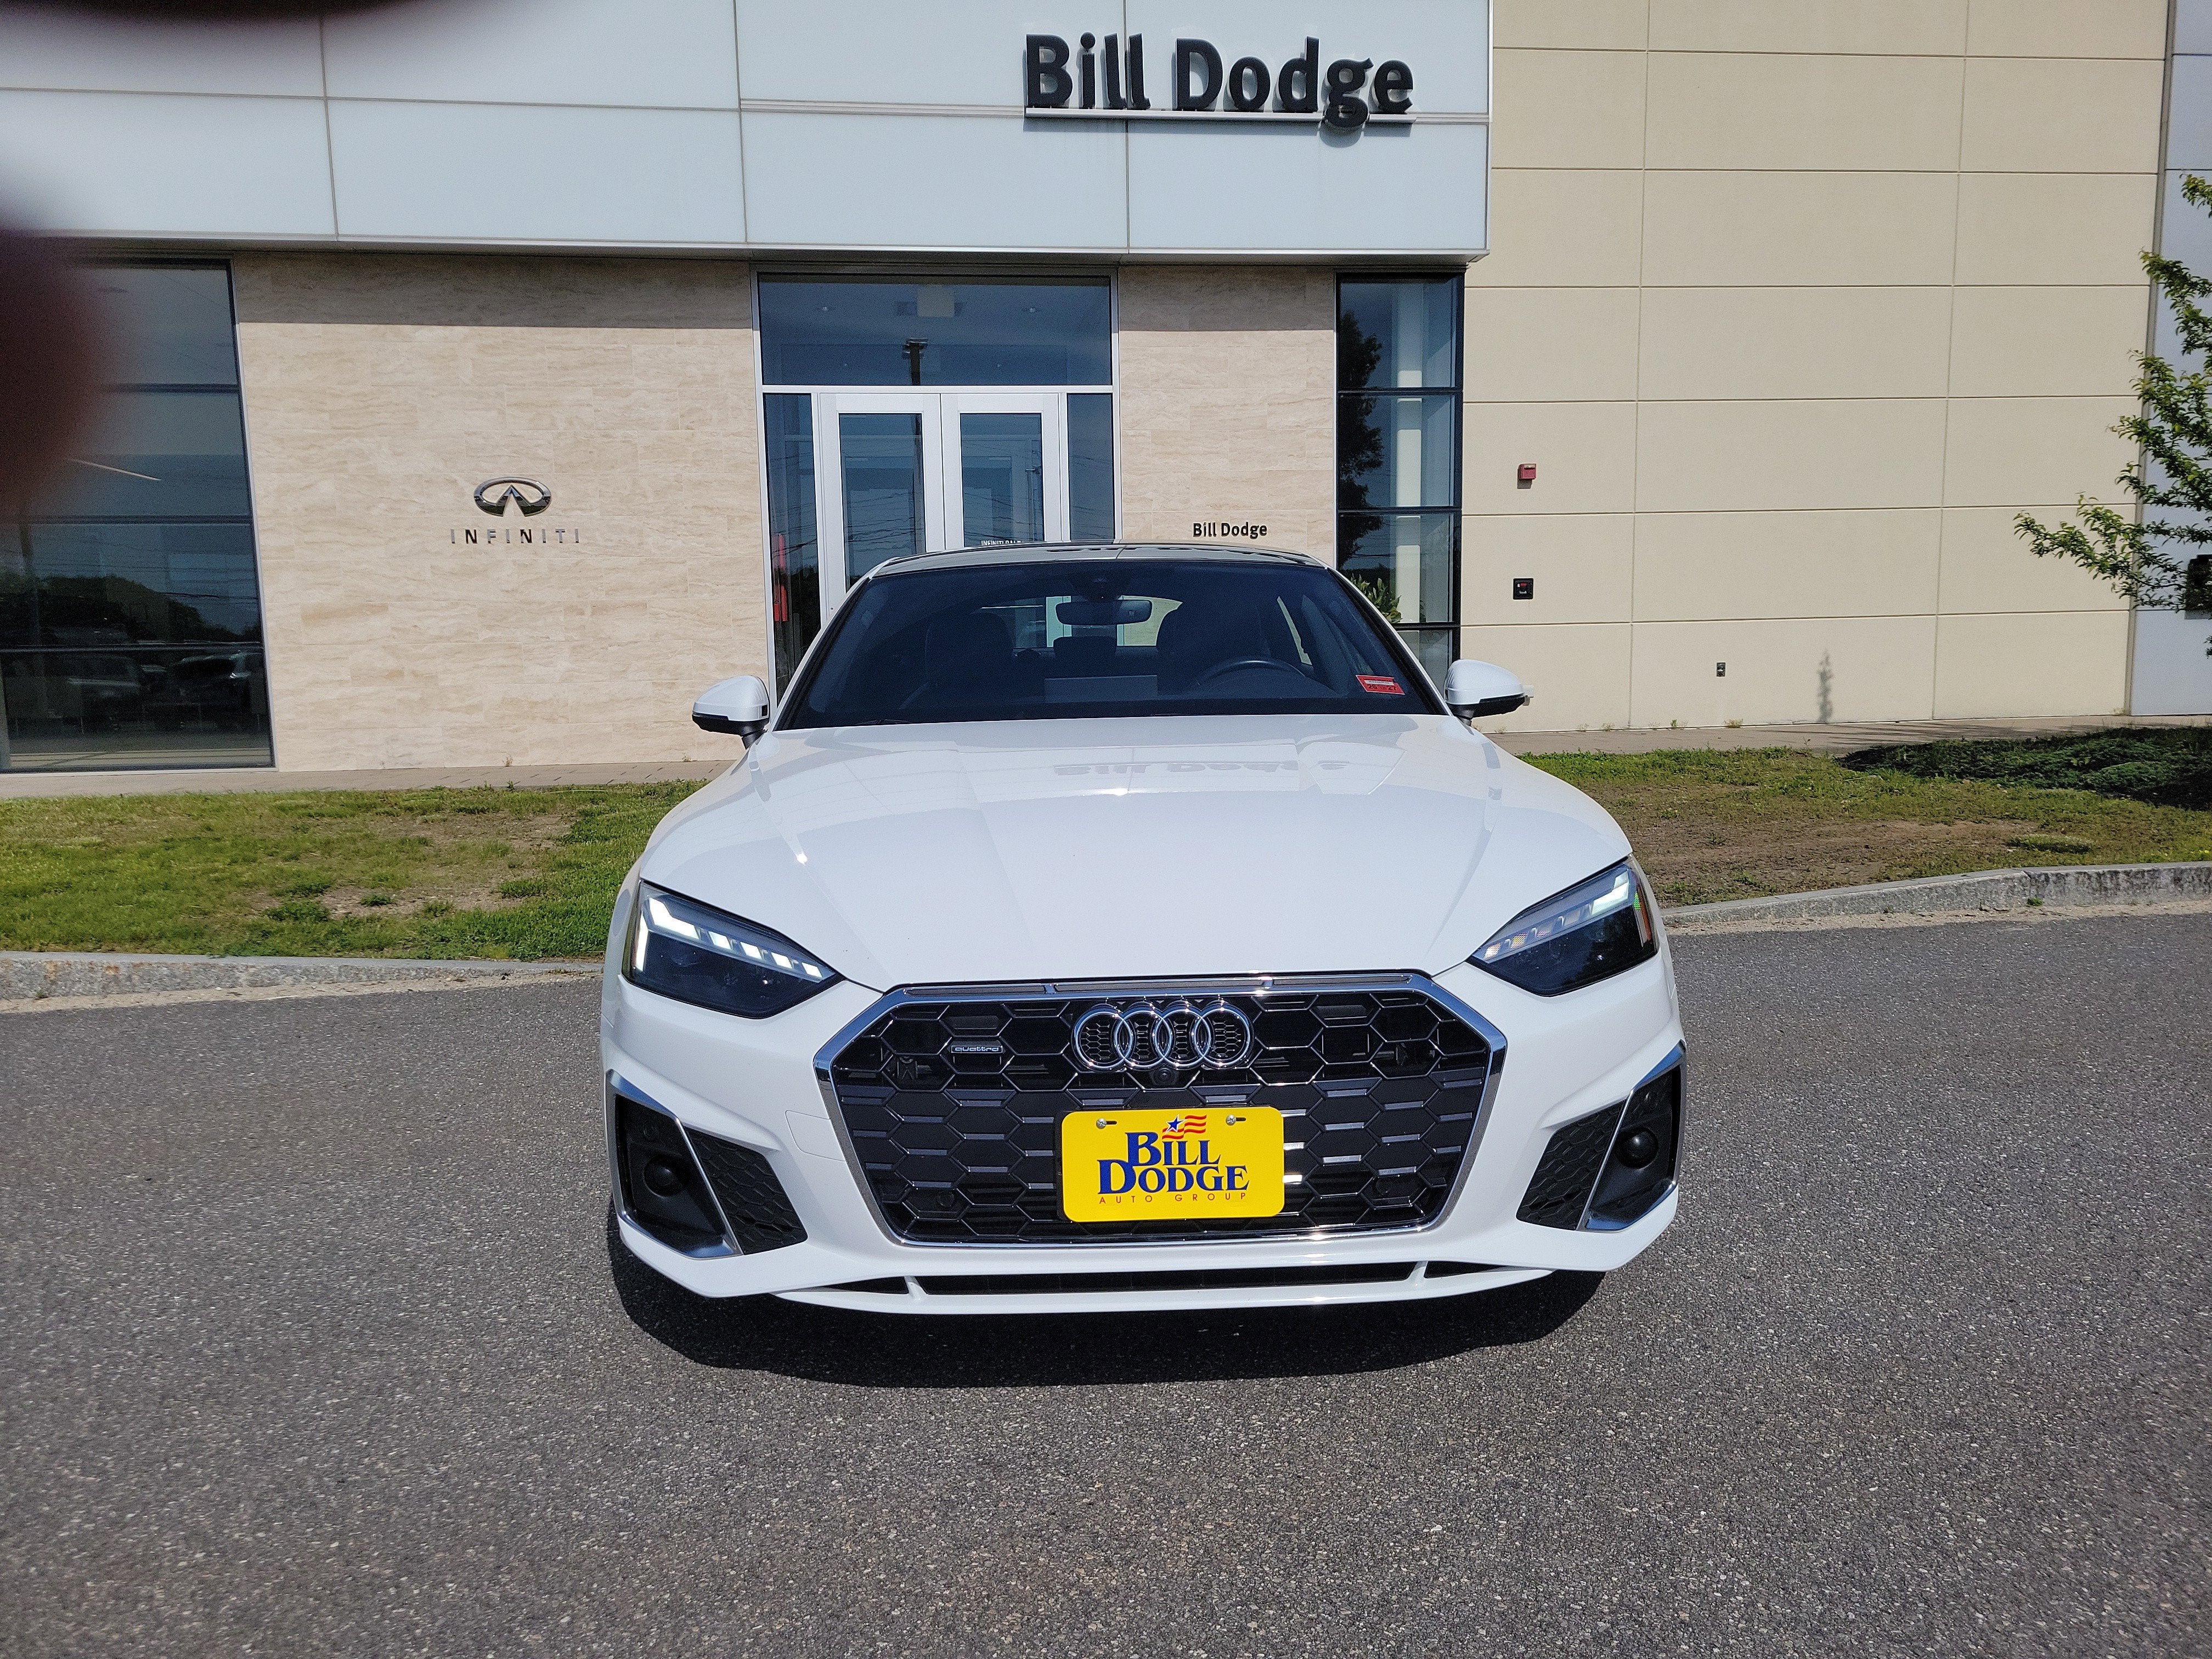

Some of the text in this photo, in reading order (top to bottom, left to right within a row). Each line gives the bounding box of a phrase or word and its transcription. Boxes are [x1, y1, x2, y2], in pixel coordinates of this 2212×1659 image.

[1025, 31, 1414, 128] Bill Dodge
[450, 528, 579, 544] INFINITI
[1193, 521, 1267, 539] Bill Dodge
[1125, 1131, 1221, 1167] BILL
[1096, 1159, 1250, 1195] DODGE
[1099, 1192, 1246, 1204] AUTO GROUP
